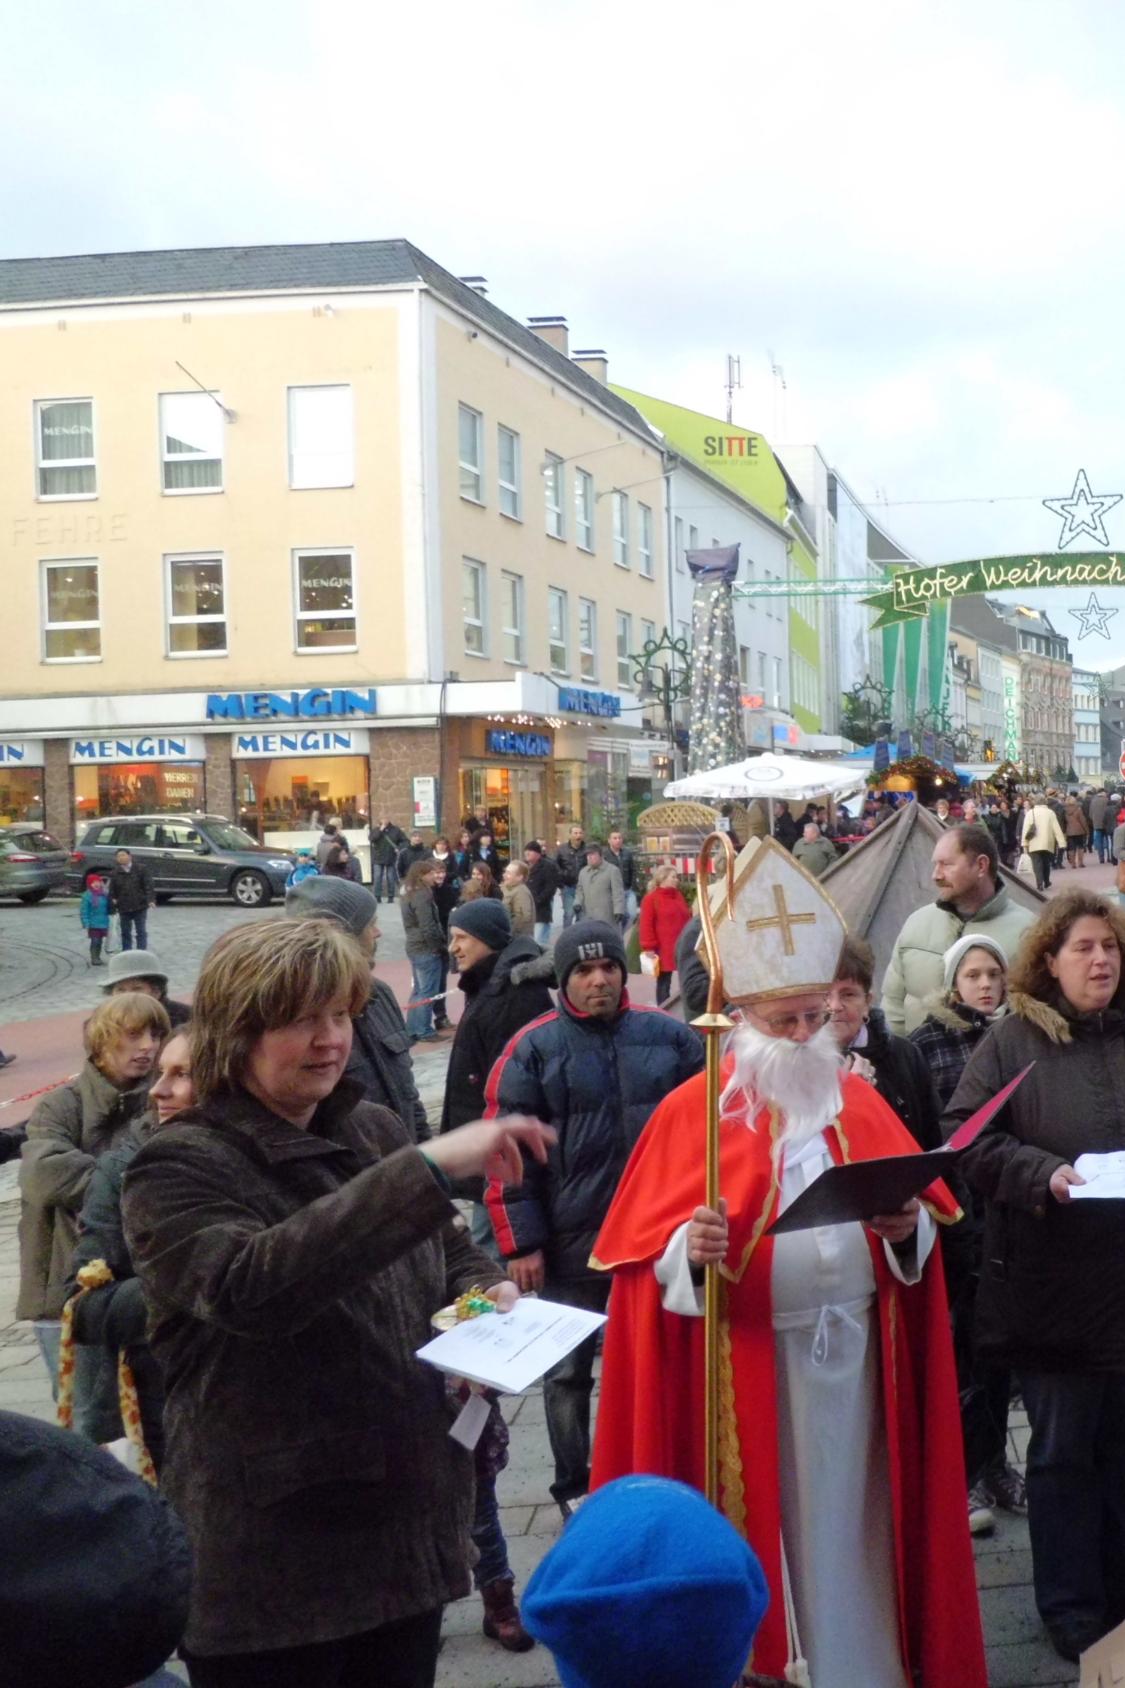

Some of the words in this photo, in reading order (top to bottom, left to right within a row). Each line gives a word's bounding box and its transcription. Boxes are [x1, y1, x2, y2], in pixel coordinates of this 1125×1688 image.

[704, 436, 758, 457] SITTE
[898, 565, 974, 604] Hofer
[206, 687, 377, 721] MENGIN
[73, 736, 187, 759] MENGIN
[236, 730, 352, 753] MENGIN
